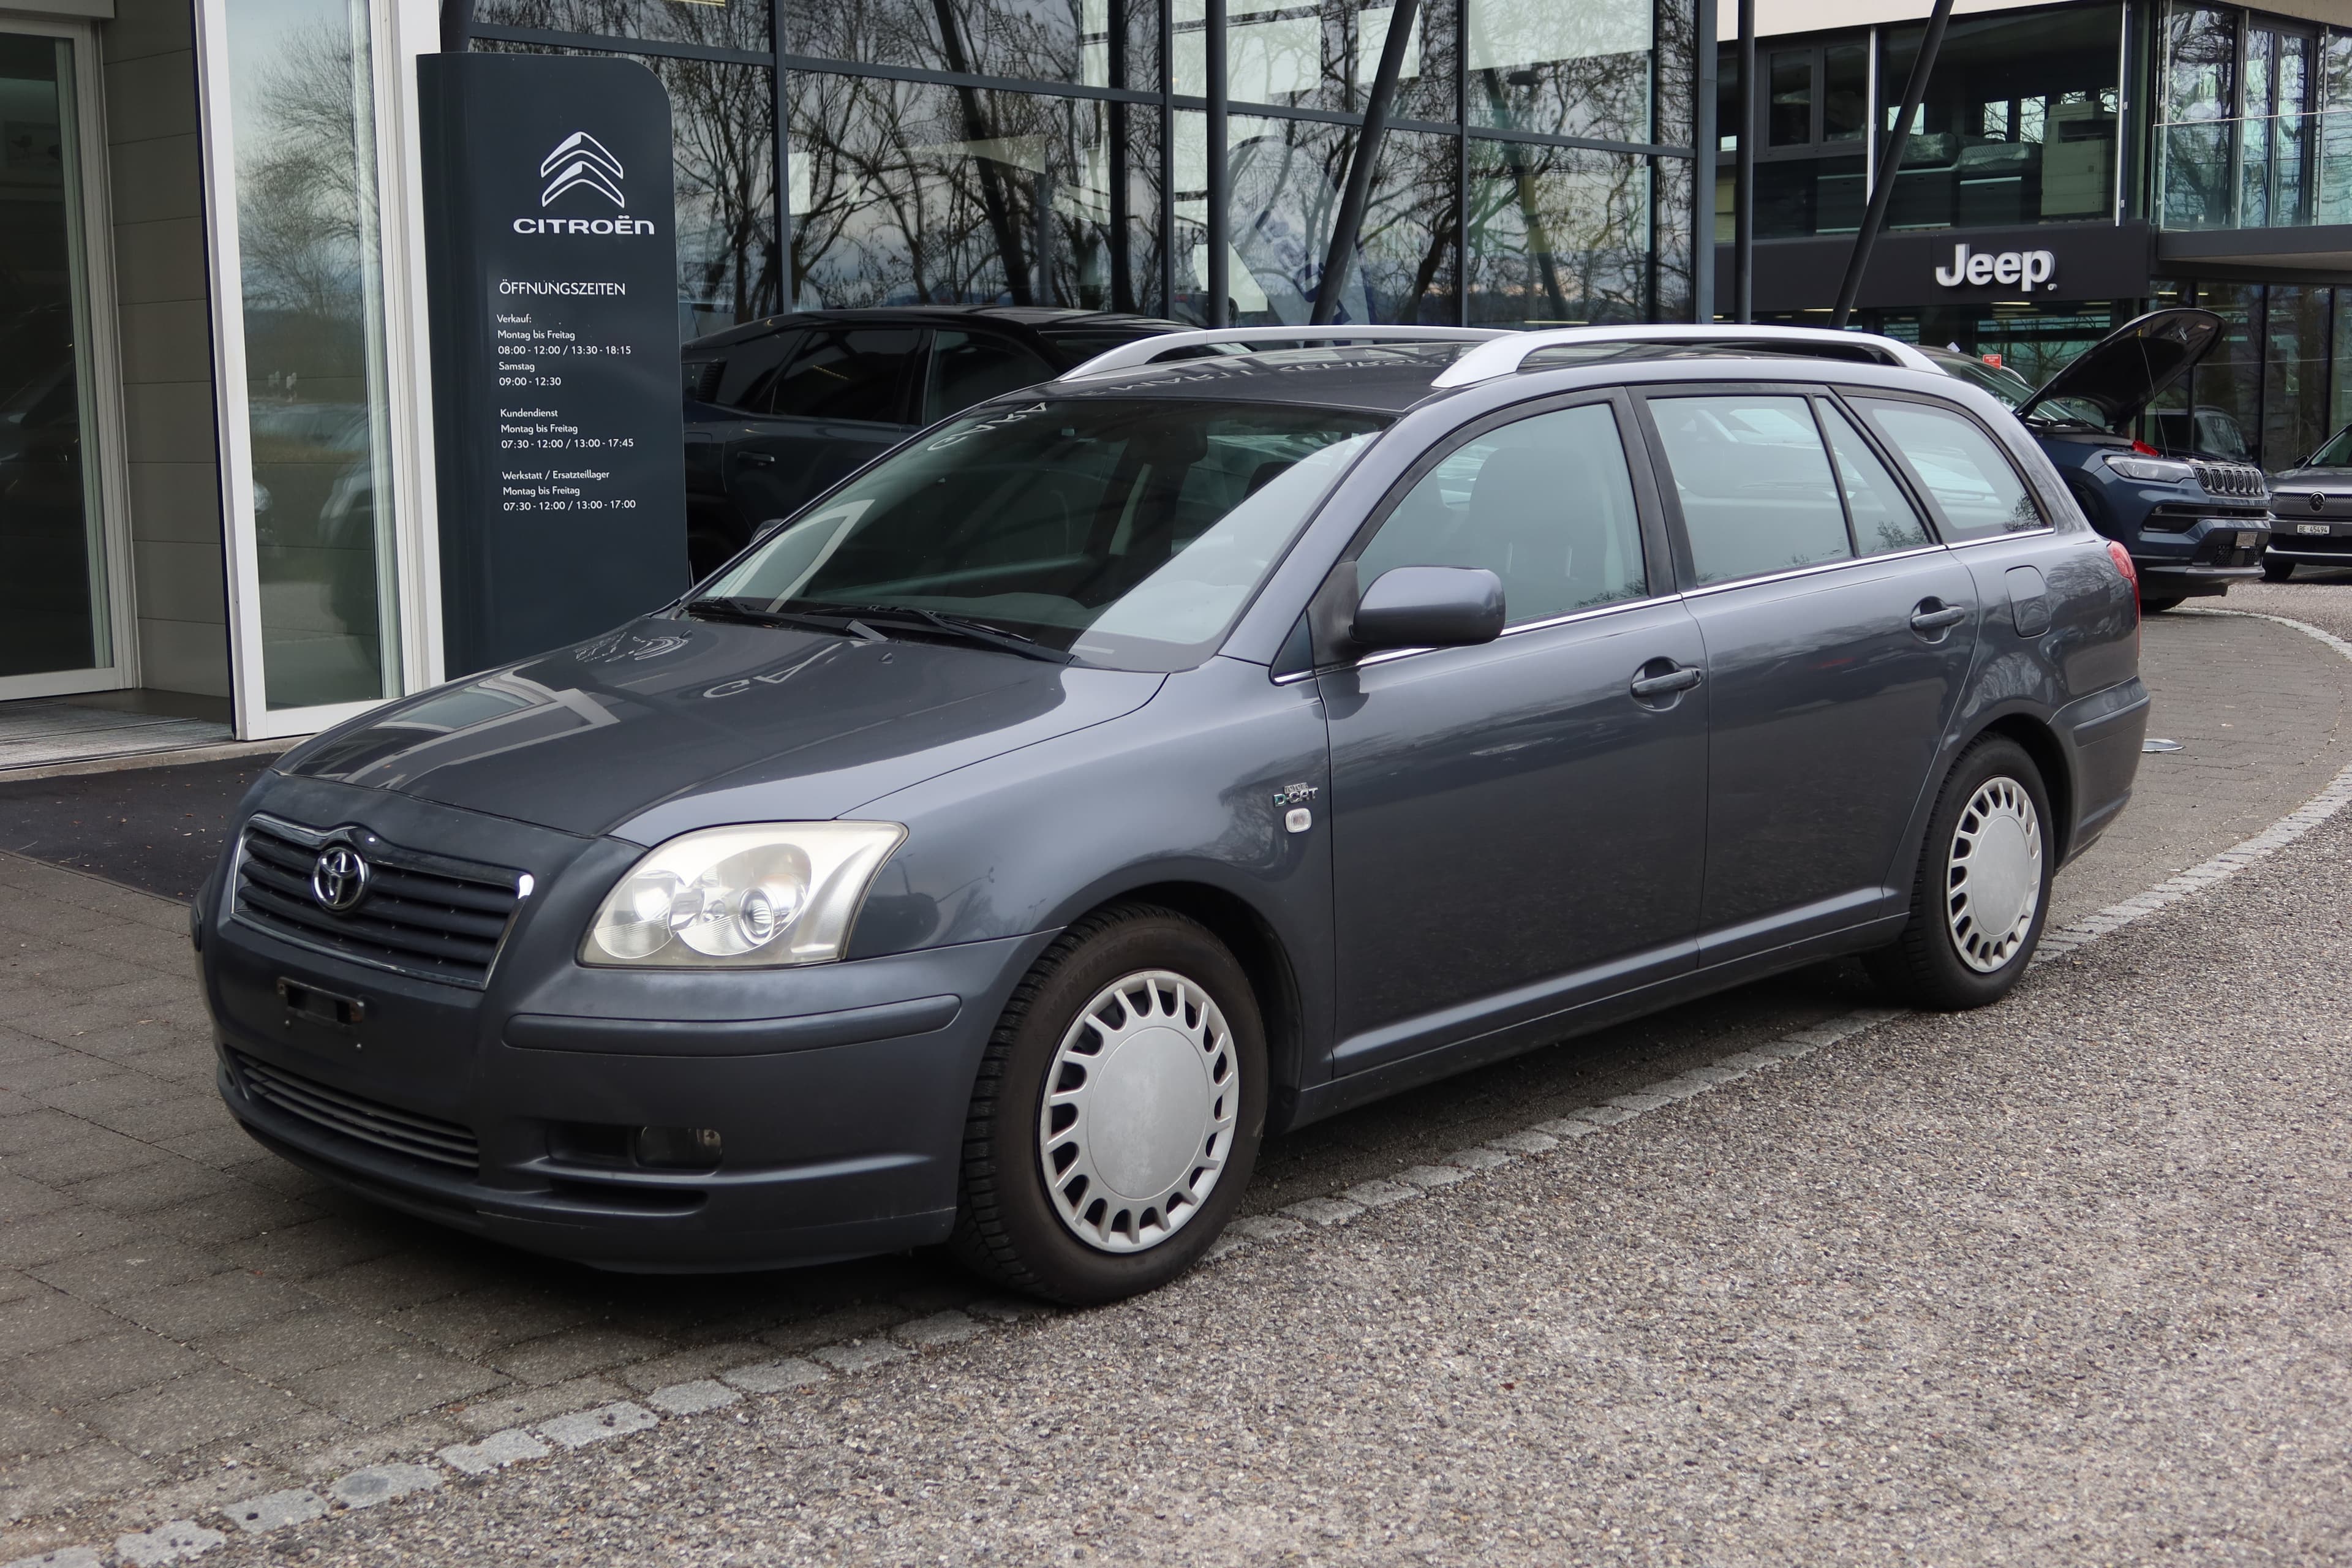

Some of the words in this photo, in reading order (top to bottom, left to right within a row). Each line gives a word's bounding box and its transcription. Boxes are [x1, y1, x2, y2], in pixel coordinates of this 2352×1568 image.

[513, 215, 654, 235] CITROËN
[1936, 244, 2056, 292] Jeep
[500, 279, 625, 295] ÖFFNUNGSZEITEN
[497, 314, 531, 323] Verkauf:
[498, 330, 530, 341] Montag
[533, 330, 545, 339] bis
[548, 330, 575, 341] Freitag
[498, 346, 526, 355] 08:00
[563, 345, 568, 355] /
[499, 361, 535, 372] Samstag
[499, 377, 527, 386] 09:00
[535, 377, 561, 386] 12:30
[500, 408, 558, 417] Kundendienst
[501, 424, 533, 435] Montag
[537, 424, 548, 432] bis
[551, 424, 578, 434] Freitag
[502, 440, 529, 448] 07:30
[537, 439, 563, 448] 12:00
[566, 439, 571, 449] /
[608, 439, 633, 447] 17:45
[502, 470, 542, 480] Werkstatt
[545, 470, 550, 480] /
[553, 469, 609, 480] Ersatzteillager
[503, 487, 535, 497] Montag
[538, 486, 550, 494] bis
[552, 486, 579, 496] Freitag
[503, 502, 531, 511] 07:30
[568, 500, 573, 510] /
[611, 500, 636, 508] 17:00
[1273, 787, 1318, 807] D-CAT
